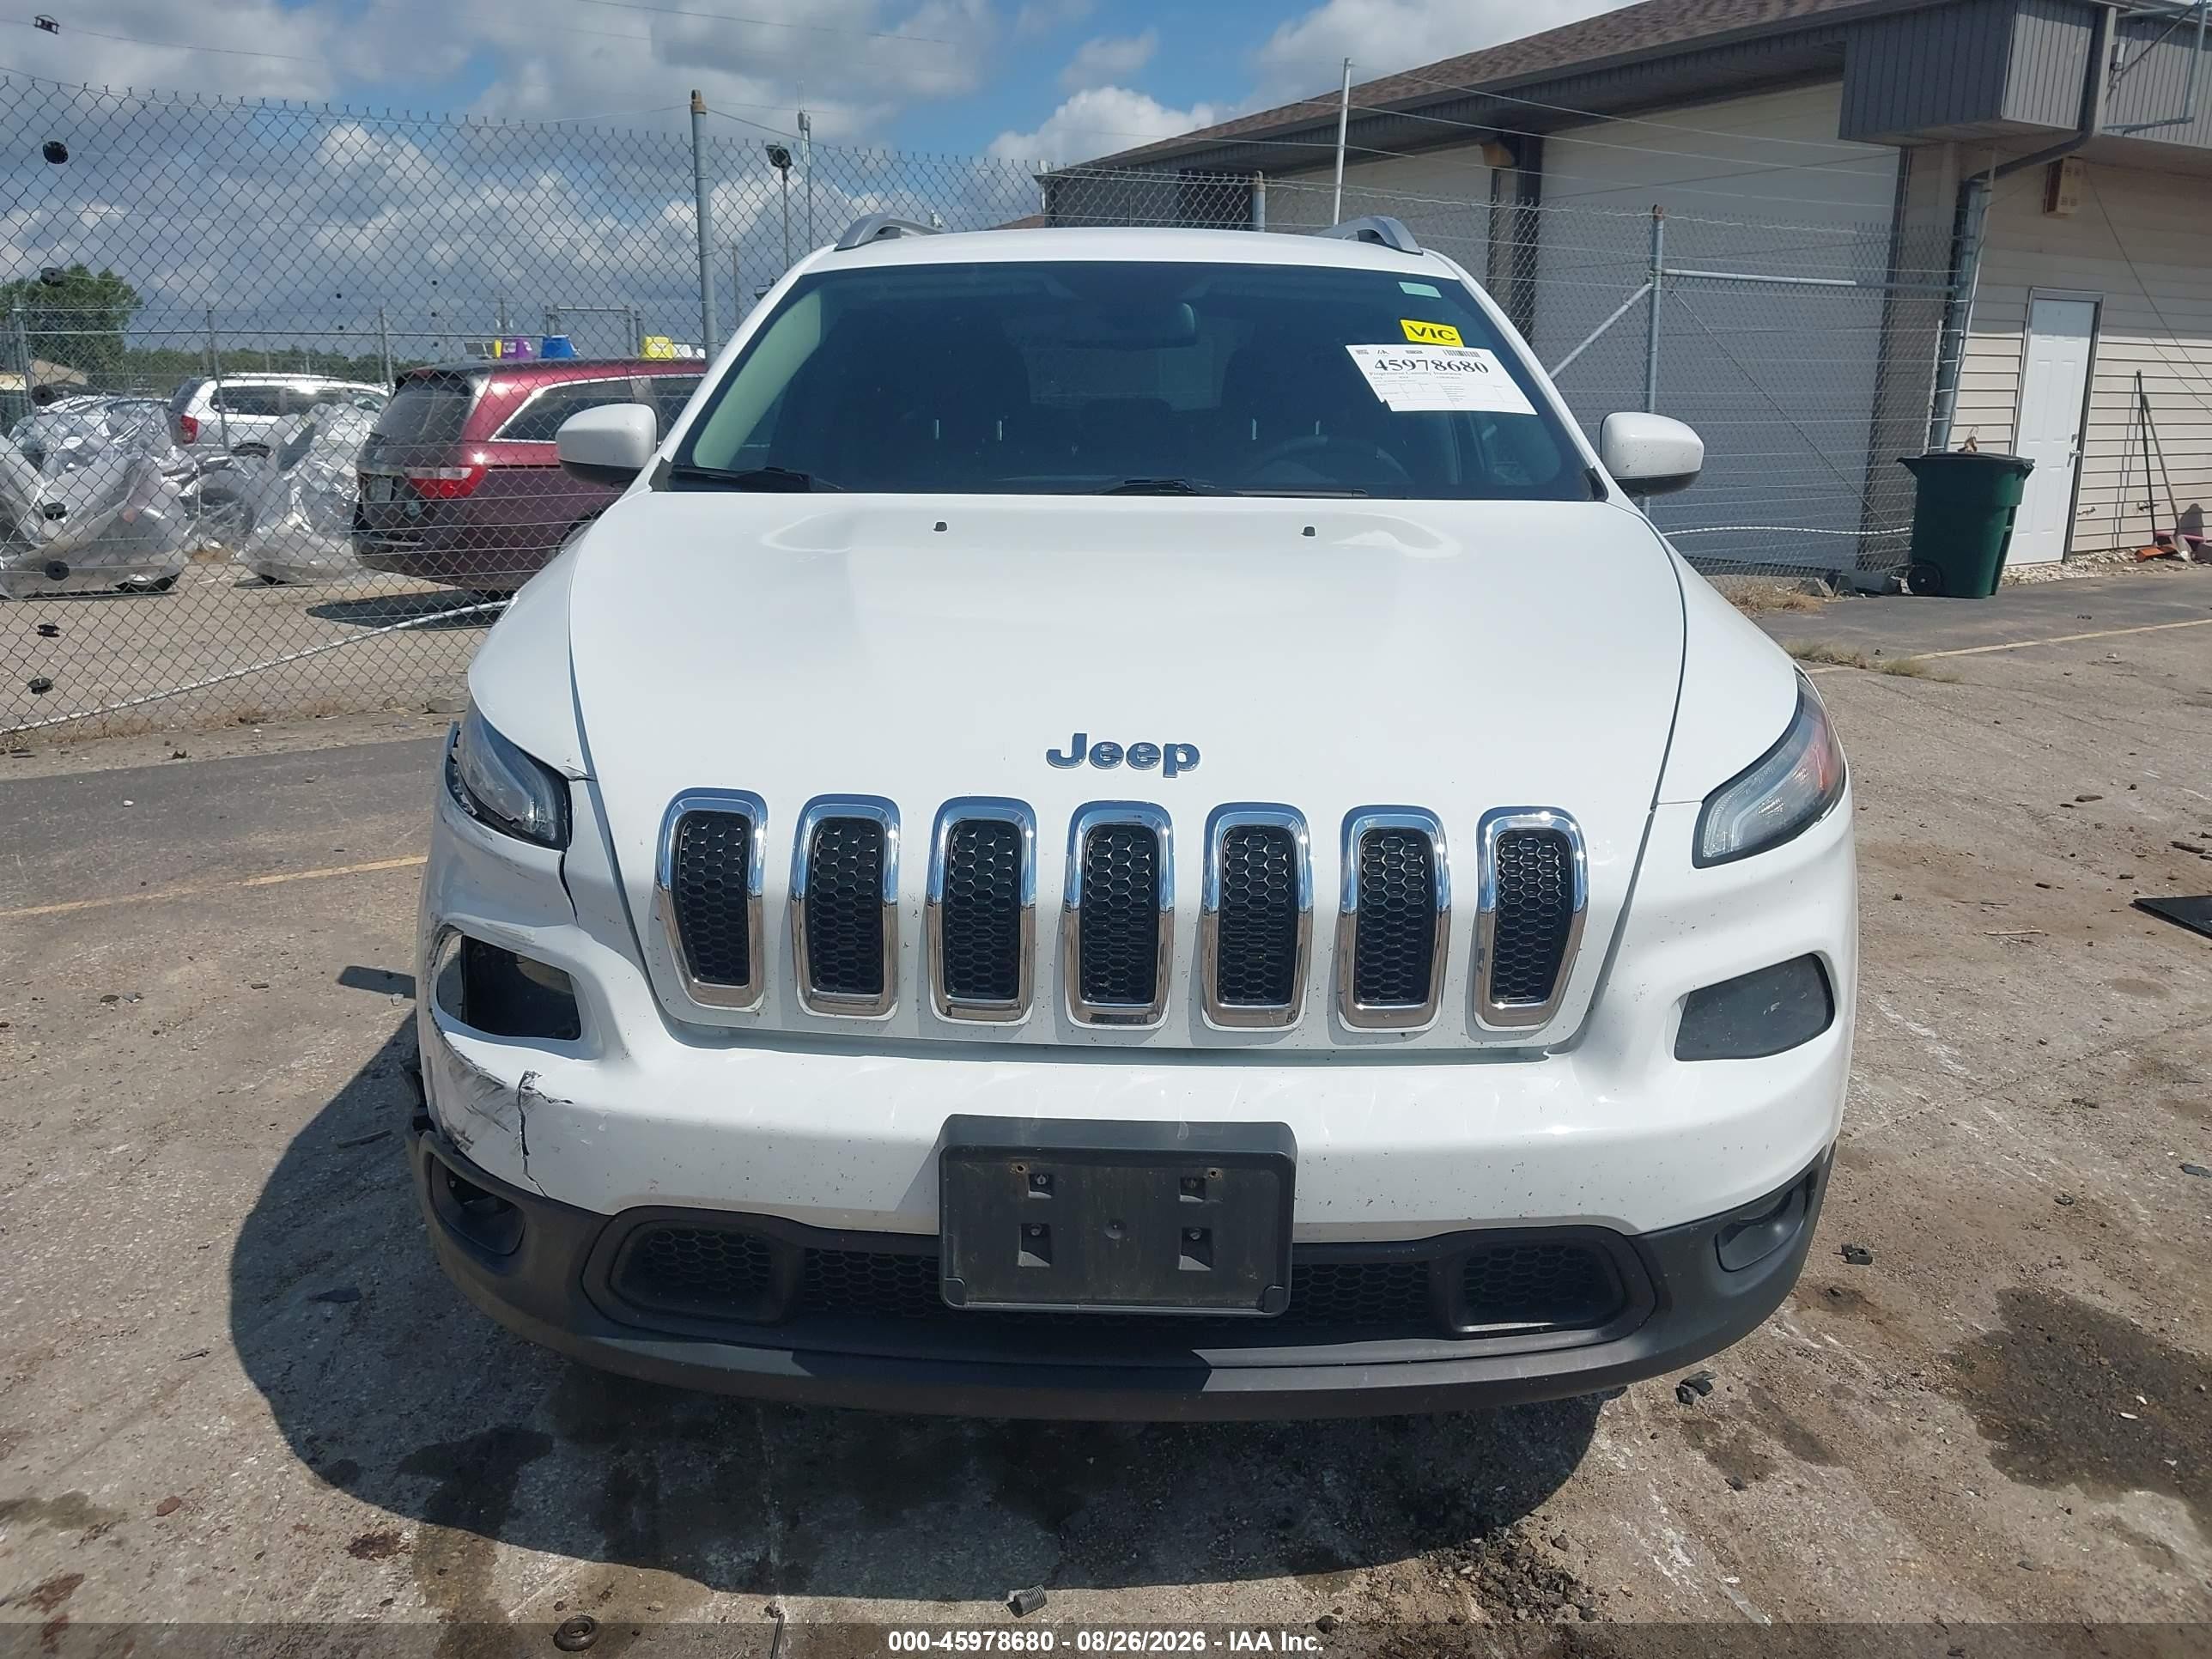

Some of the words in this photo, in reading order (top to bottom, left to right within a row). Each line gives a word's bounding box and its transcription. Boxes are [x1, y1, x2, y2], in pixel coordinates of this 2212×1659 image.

[1408, 325, 1456, 341] VIC
[1375, 359, 1489, 374] 45978680
[1046, 732, 1201, 778] Jeep
